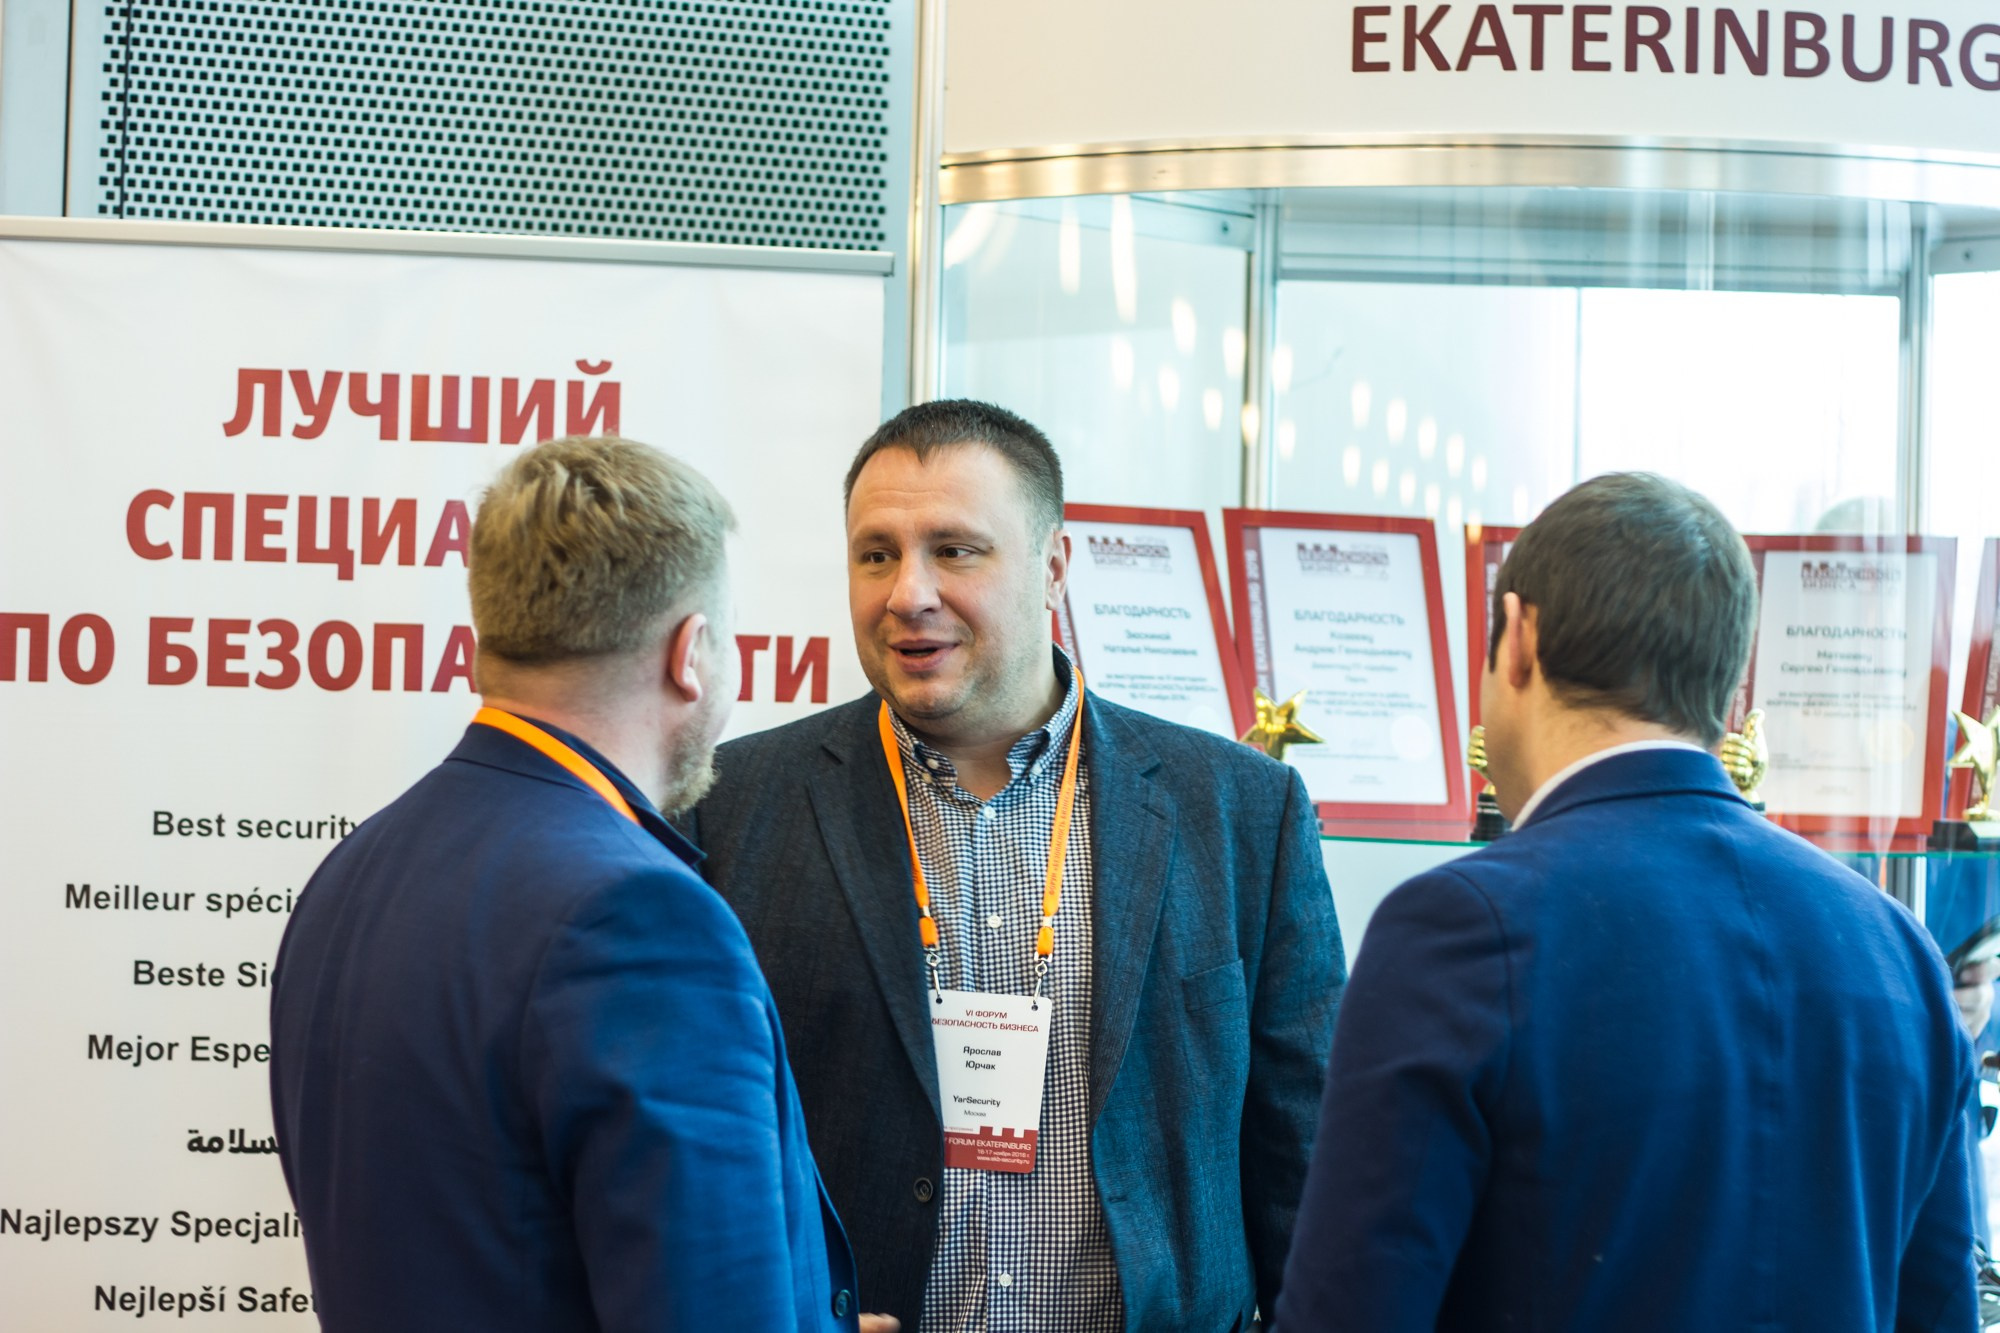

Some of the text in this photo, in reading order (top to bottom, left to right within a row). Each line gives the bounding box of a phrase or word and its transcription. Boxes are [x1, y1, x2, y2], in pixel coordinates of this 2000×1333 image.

[1351, 4, 2000, 90] EKATERINBURG
[223, 359, 621, 444] ЛУЧШИЙ
[126, 489, 470, 581] СПЕЦИА
[1094, 604, 1191, 619] БЛАГОДАРНОСТЬ
[1294, 609, 1404, 625] БЛАГОДАРНОСТЬ
[1786, 625, 1907, 640] БЛАГОДАРНОСТЬ
[0, 613, 115, 685] ПО
[153, 811, 226, 837] Best
[65, 884, 300, 918] Meilleur spéci
[134, 961, 225, 987] Beste
[931, 1018, 1039, 1033] БЕЗОПАСНОСТЬ БИЗНЕСА
[975, 1010, 1008, 1019] ФОРУМ
[88, 1035, 271, 1068] Mejor Espe
[963, 1046, 1002, 1057] Ярослав
[965, 1060, 996, 1071] Юрчак
[952, 1095, 1001, 1108] YarSecurity
[187, 1128, 280, 1154] سلامة
[948, 1137, 976, 1146] FORUM
[976, 1139, 1032, 1151] EKATERINBURG
[0, 1209, 304, 1244] Najlepszy Specjali
[94, 1285, 226, 1317] Nejlepší
